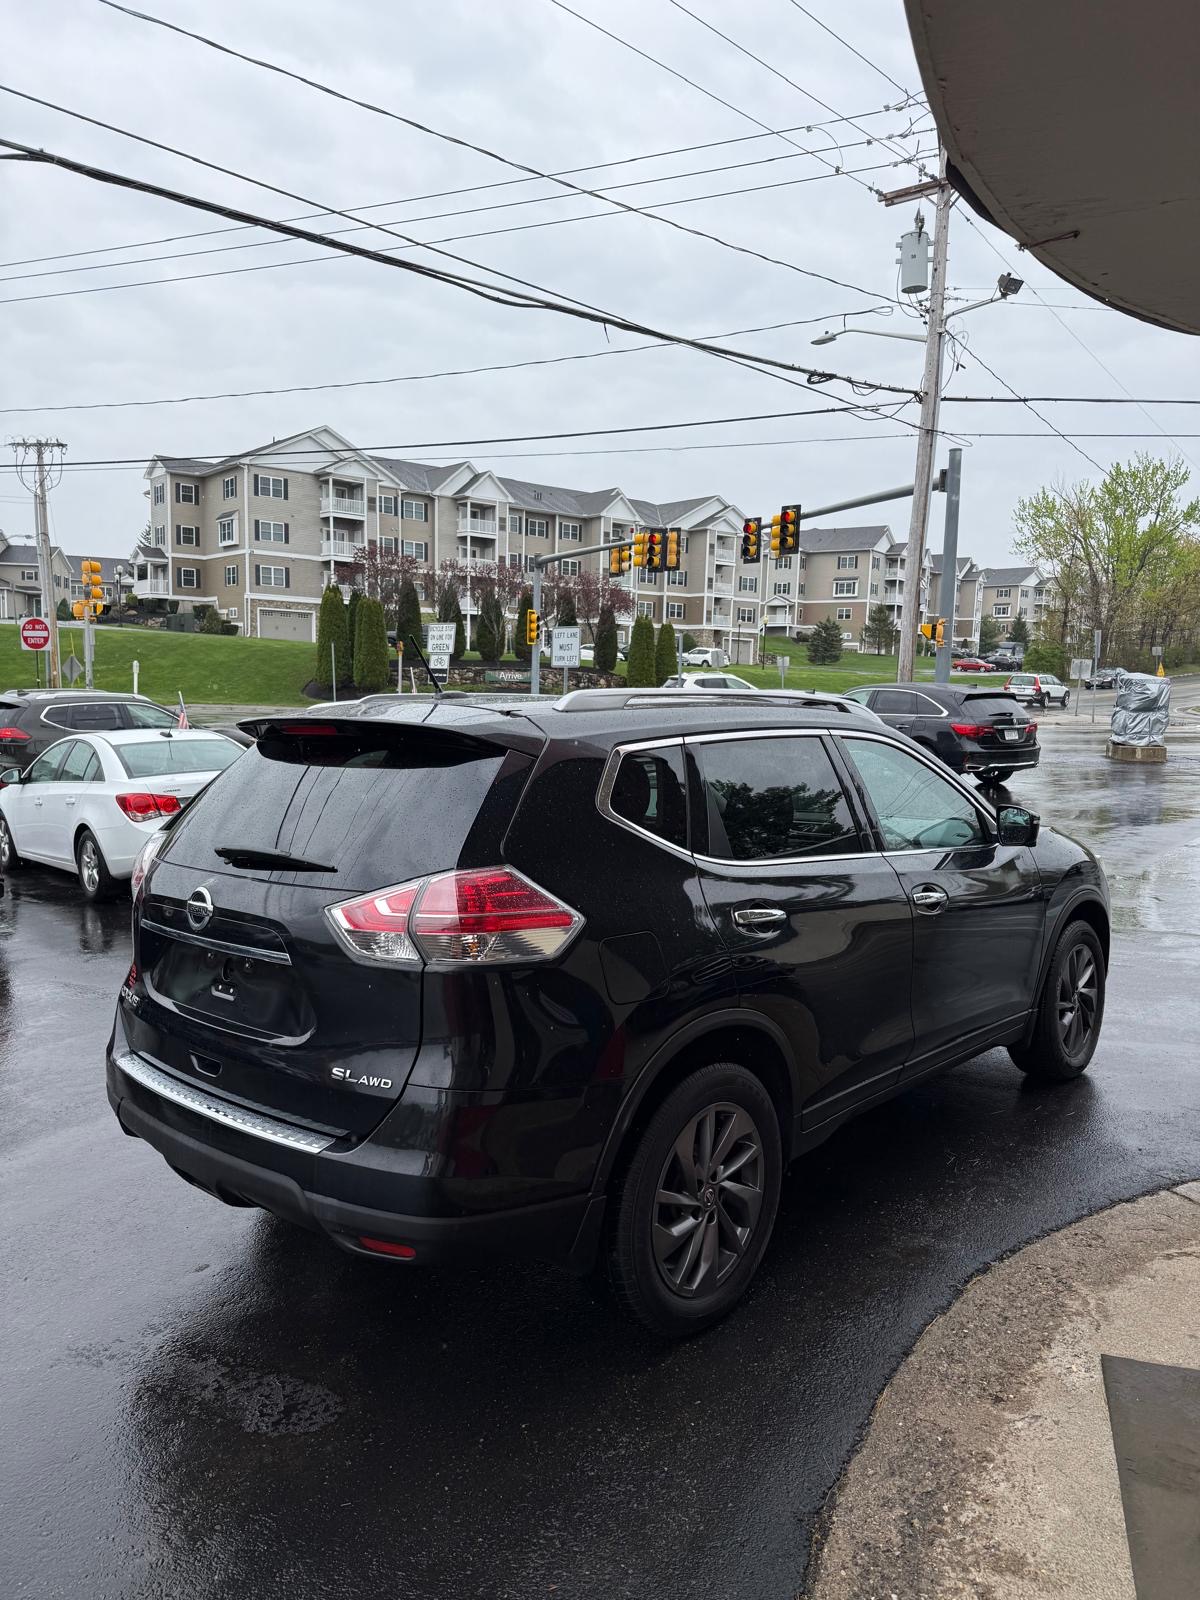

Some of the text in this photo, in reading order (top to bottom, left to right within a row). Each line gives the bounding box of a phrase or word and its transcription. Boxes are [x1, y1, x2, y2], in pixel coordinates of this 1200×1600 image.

[554, 631, 578, 639] LEFT LANE
[431, 643, 450, 651] GREEN
[559, 643, 573, 651] MUST
[499, 671, 523, 681] Arrive
